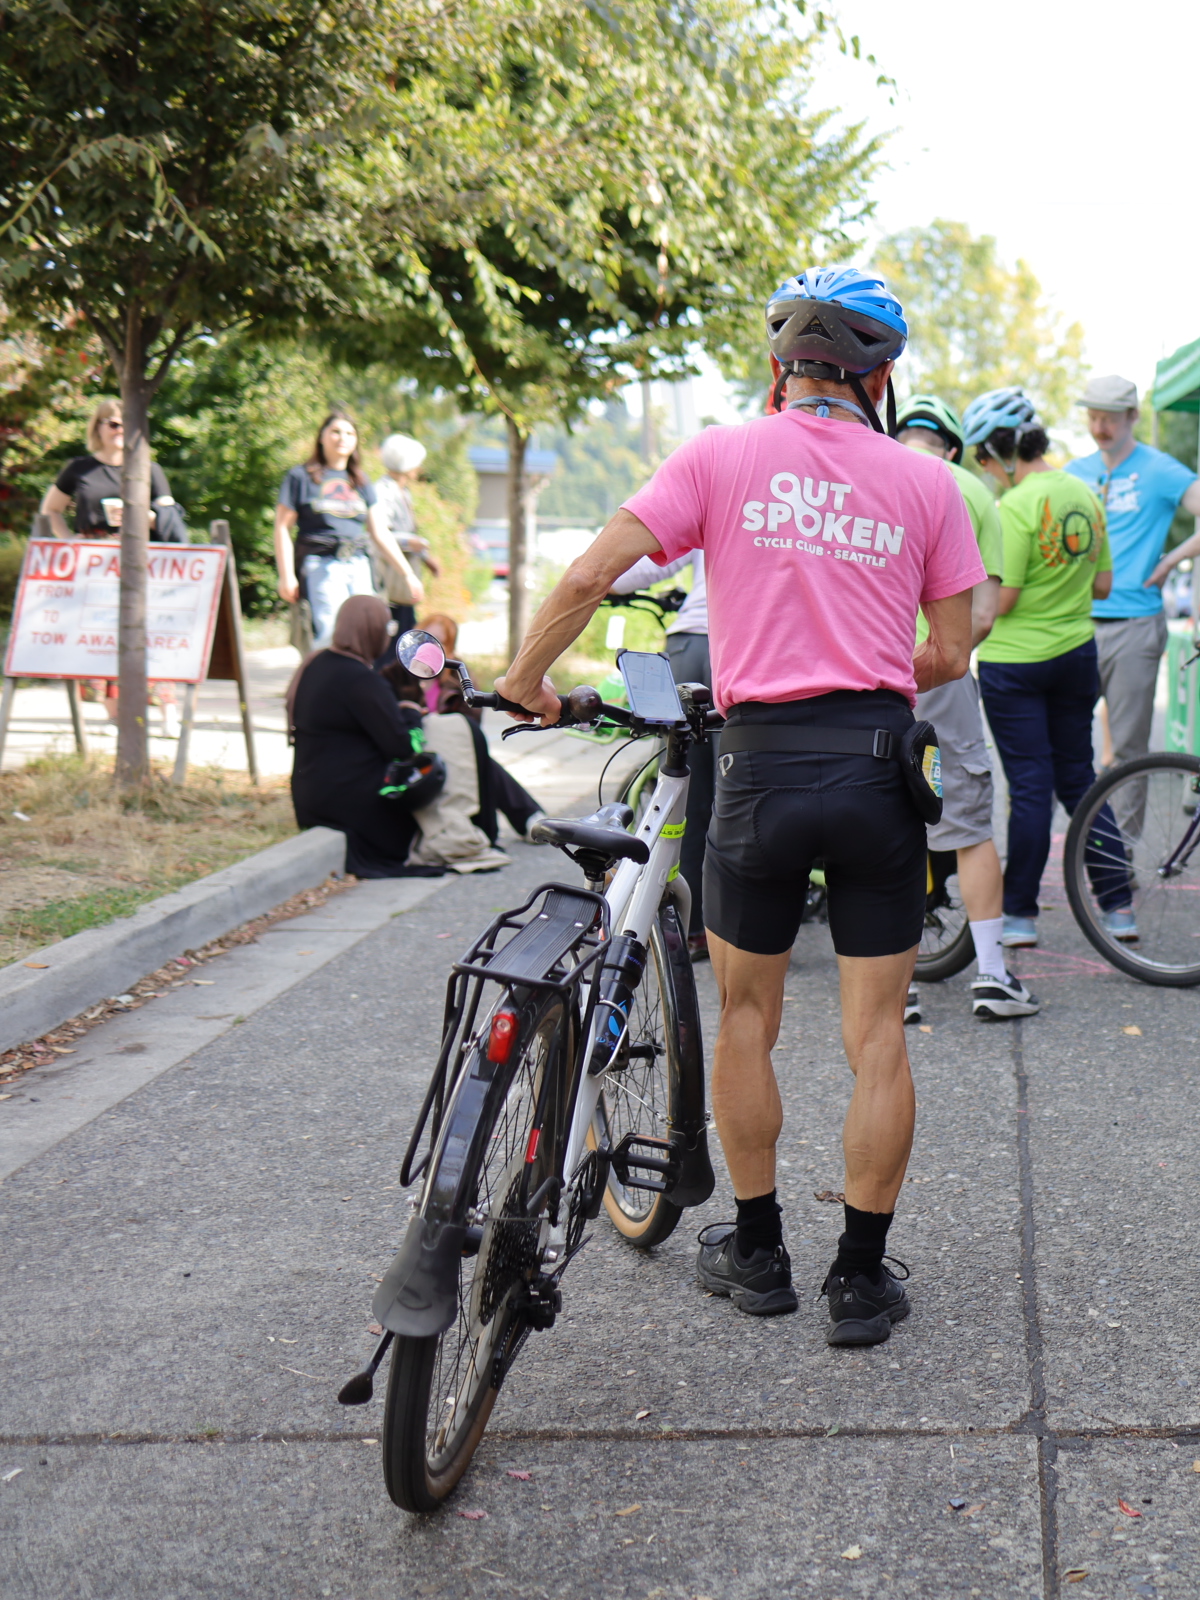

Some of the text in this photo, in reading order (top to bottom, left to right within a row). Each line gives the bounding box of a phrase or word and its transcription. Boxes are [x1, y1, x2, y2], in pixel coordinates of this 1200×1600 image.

[770, 472, 851, 511] OUT
[742, 500, 904, 555] SPOKEN
[29, 545, 206, 581] NO PAKING
[754, 536, 887, 567] CYCLE CLUB SEATTLE
[36, 585, 75, 599] FROM
[43, 609, 59, 623] TO
[32, 631, 68, 645] TOW
[77, 634, 117, 647] AWA
